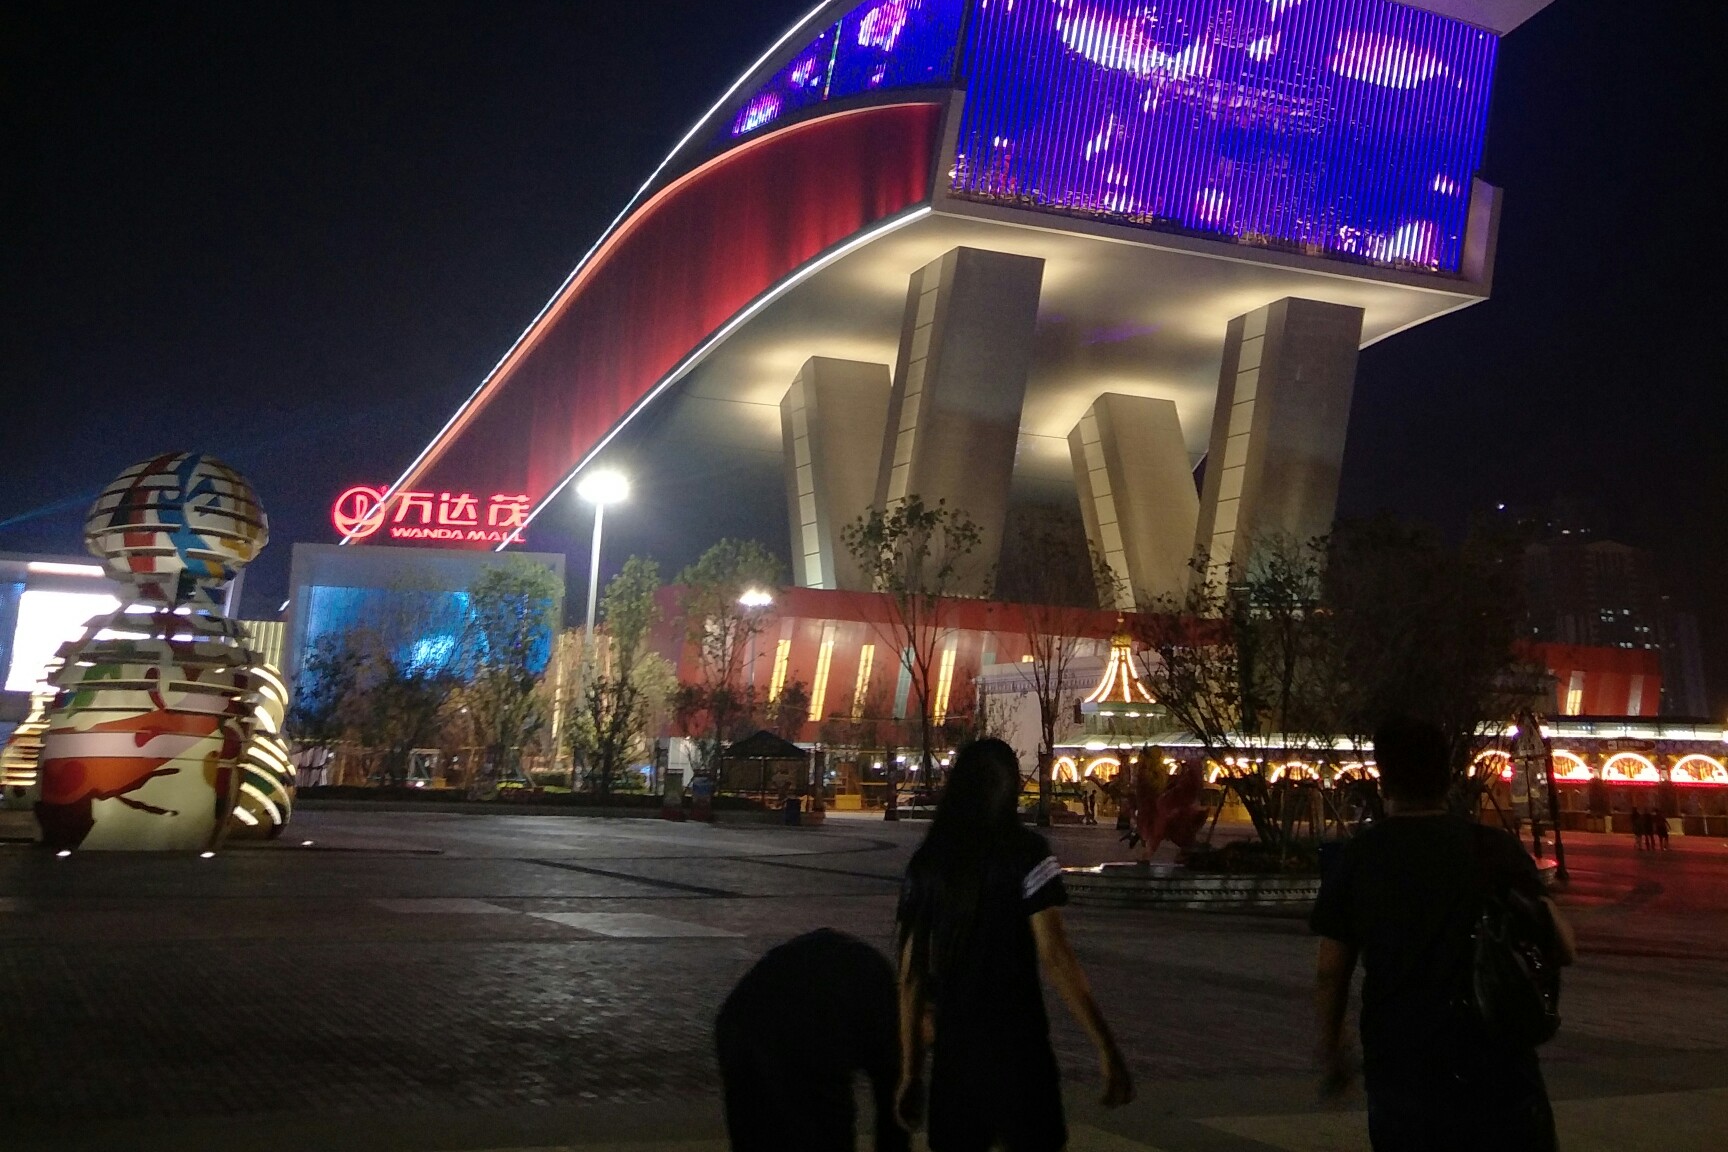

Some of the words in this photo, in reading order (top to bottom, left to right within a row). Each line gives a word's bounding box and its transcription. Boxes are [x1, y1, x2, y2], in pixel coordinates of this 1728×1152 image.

[393, 492, 530, 527] 万达茂
[391, 528, 464, 540] WANDA
[466, 530, 526, 542] MALL
